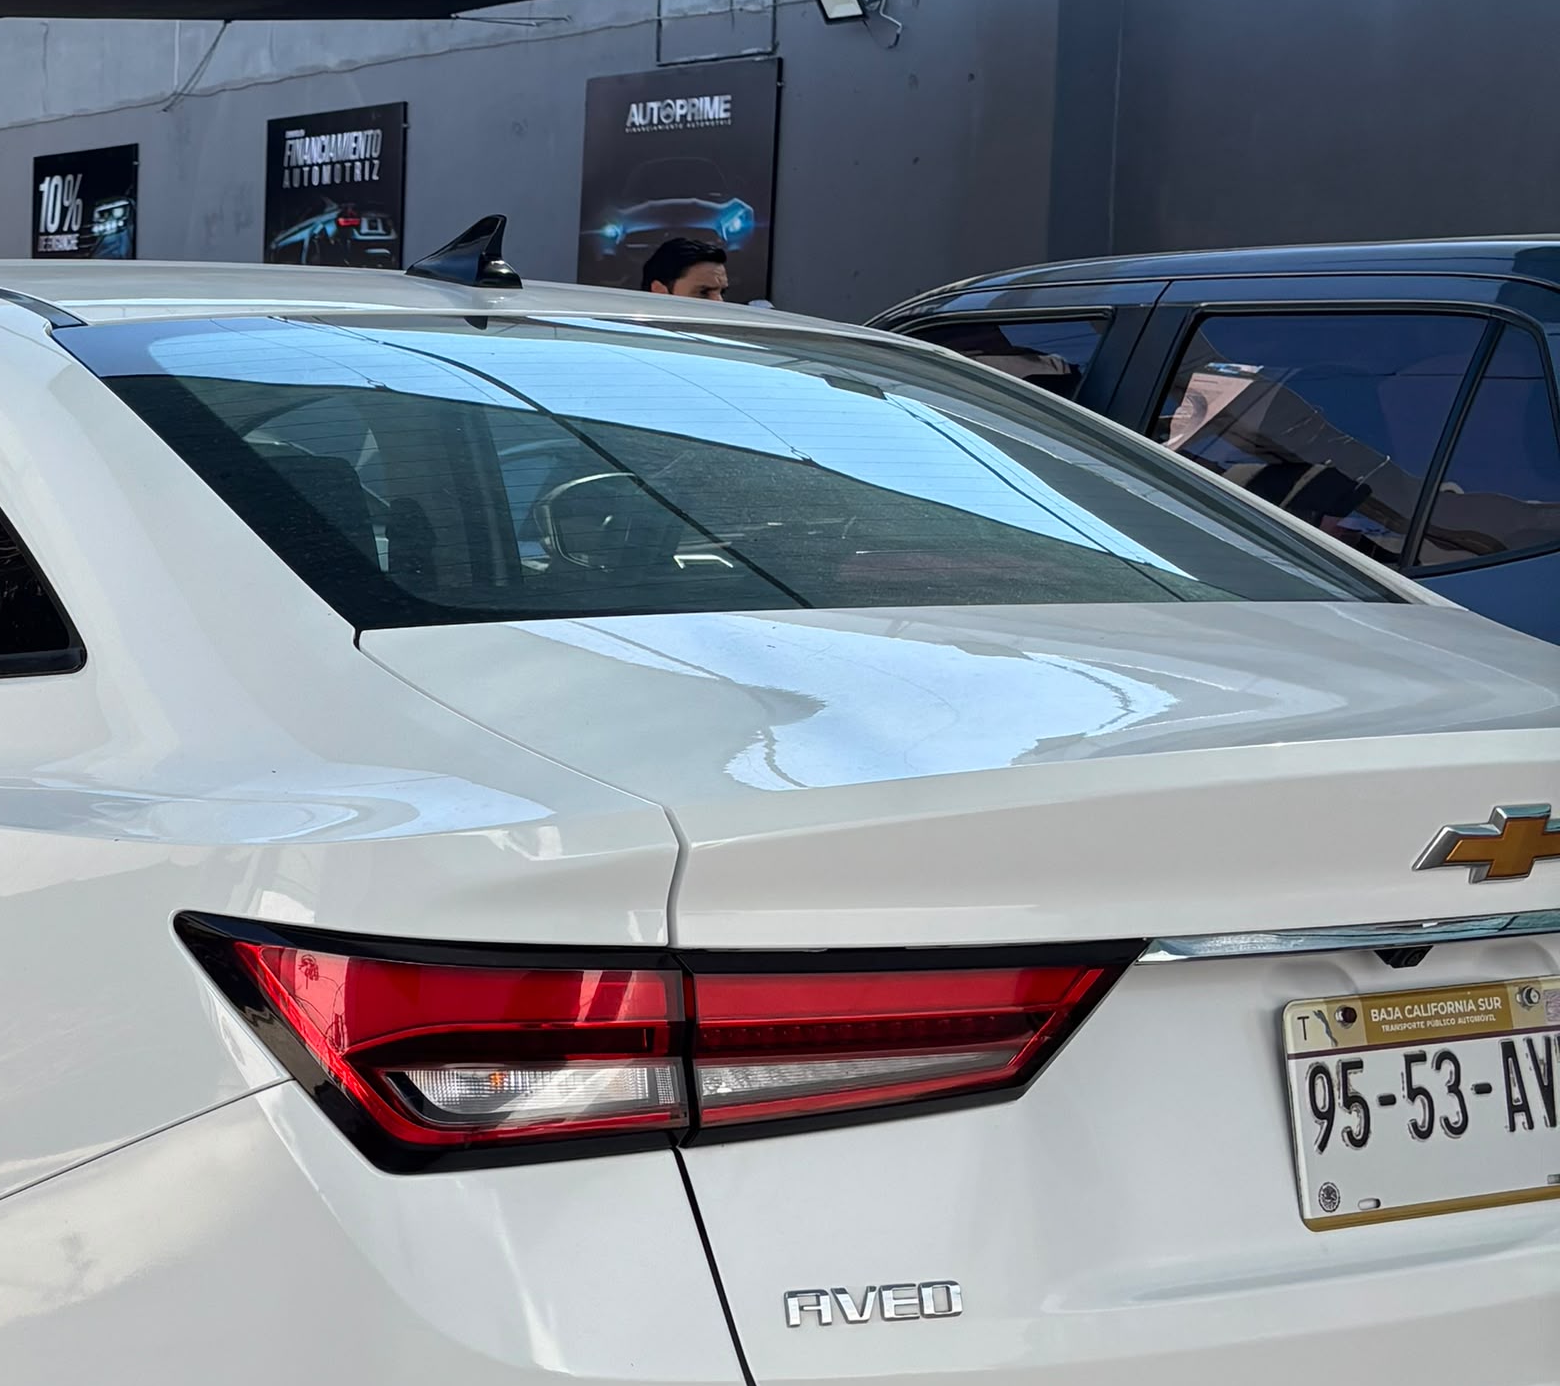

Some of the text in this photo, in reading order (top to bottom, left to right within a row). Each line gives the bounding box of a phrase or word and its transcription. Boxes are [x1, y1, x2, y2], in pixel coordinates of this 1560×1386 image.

[626, 95, 732, 127] AUTOPRIME
[283, 129, 382, 168] FINANCIAMIENTO
[282, 159, 380, 189] AUTOMOTRIZ
[38, 173, 83, 233] 10%
[1371, 997, 1502, 1022] BAJA CALIFORNIA SUR
[1297, 1016, 1310, 1041] T
[1381, 1019, 1425, 1033] TRANSPORTE
[1305, 1035, 1560, 1154] 95-53-AV
[784, 1280, 963, 1328] AVEO
